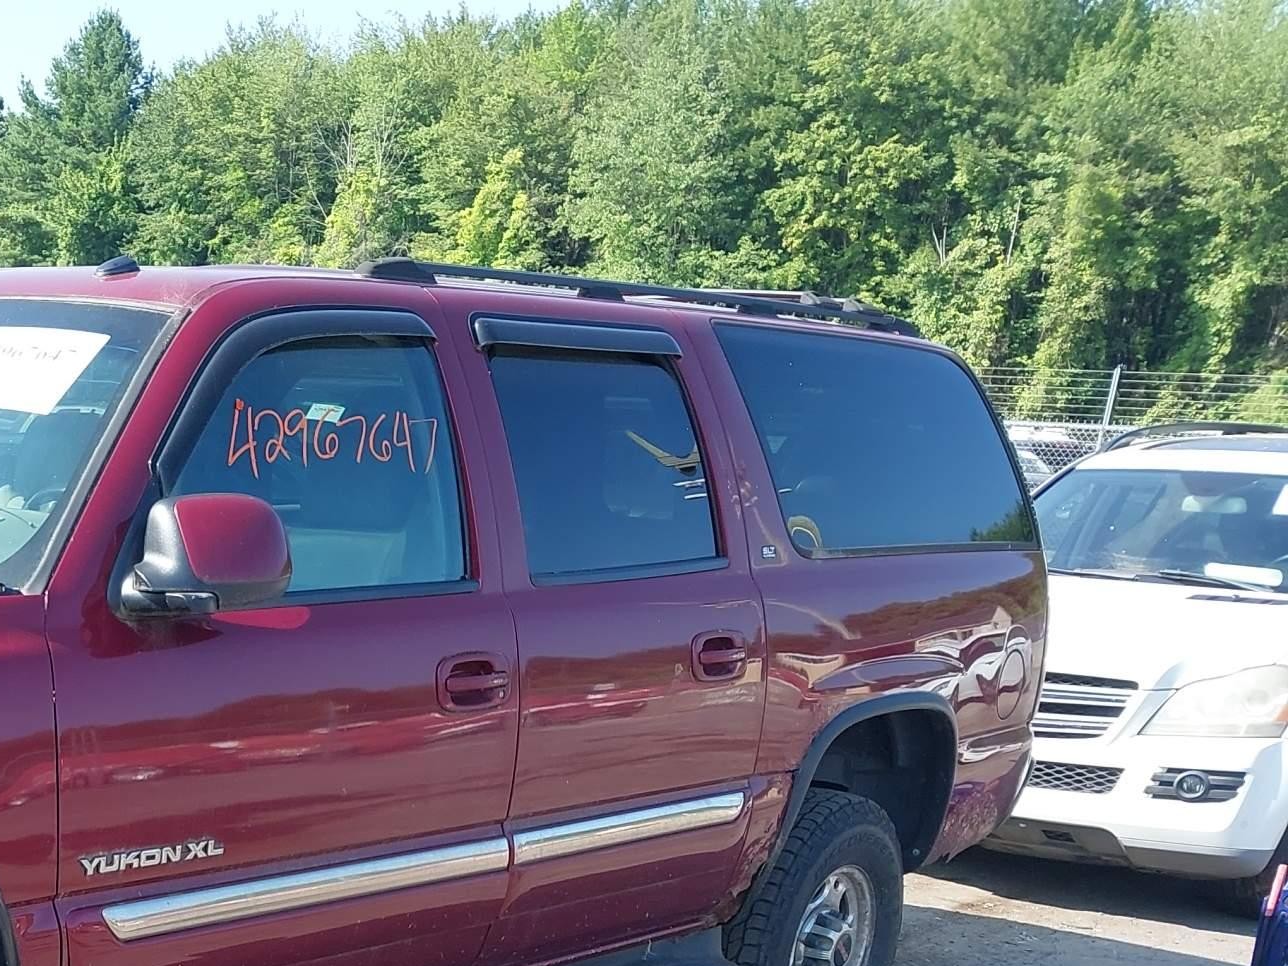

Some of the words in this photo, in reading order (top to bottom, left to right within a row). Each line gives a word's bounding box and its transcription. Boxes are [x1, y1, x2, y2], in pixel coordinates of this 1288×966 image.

[227, 399, 438, 480] 42967647
[80, 845, 183, 876] YUKON
[185, 839, 226, 861] XL
